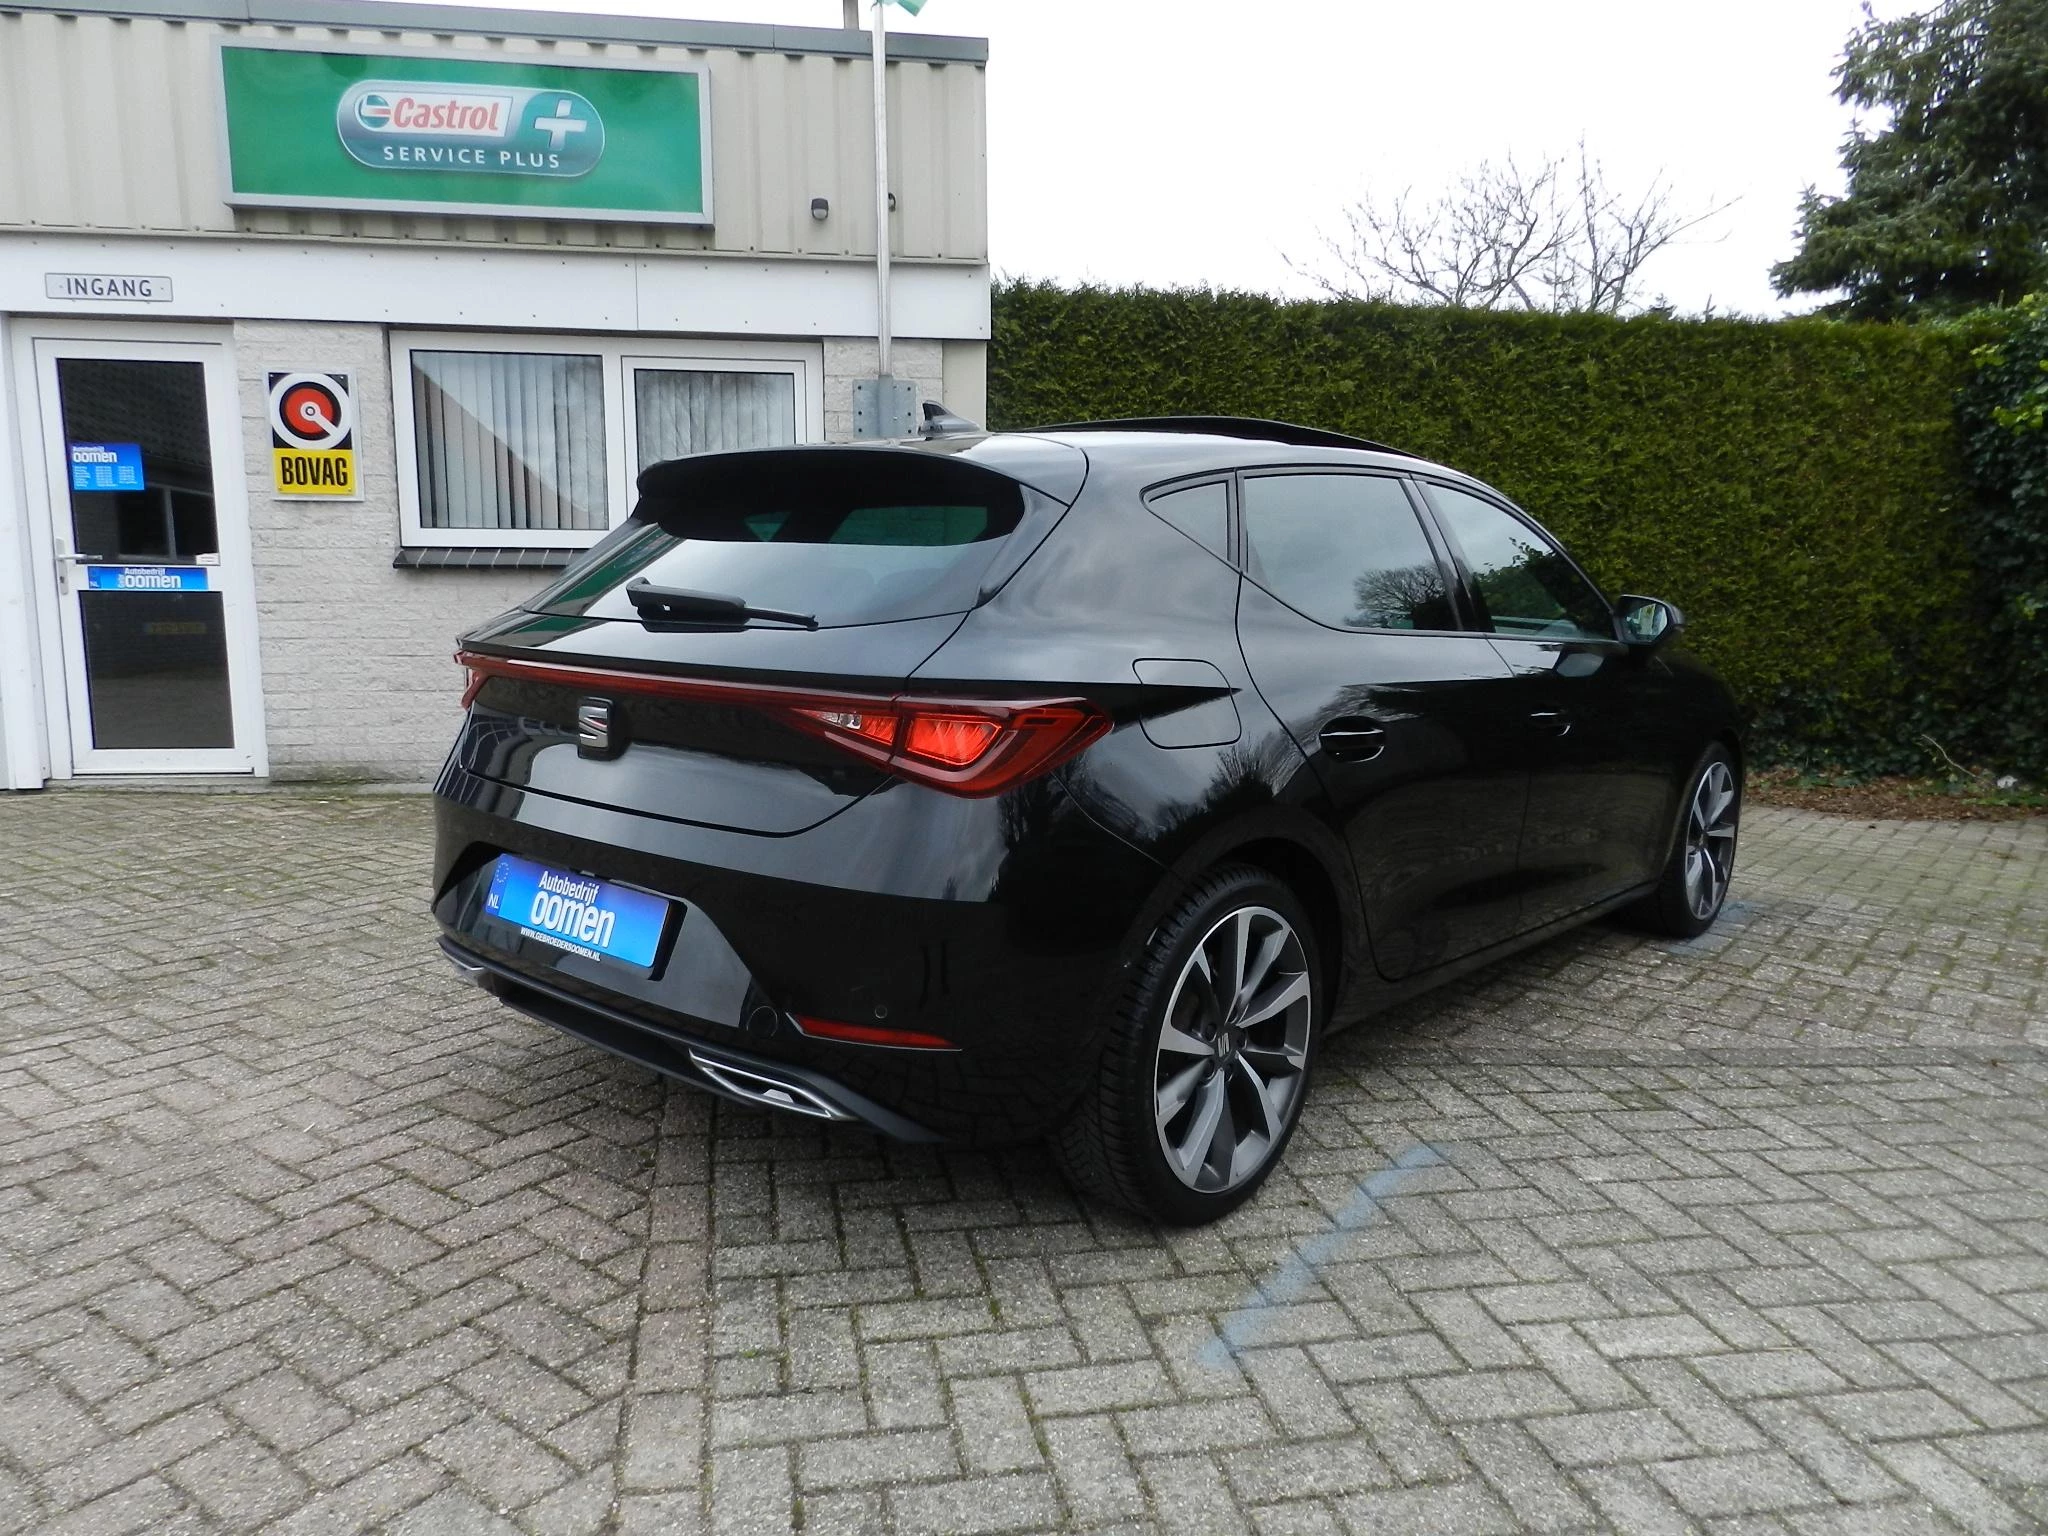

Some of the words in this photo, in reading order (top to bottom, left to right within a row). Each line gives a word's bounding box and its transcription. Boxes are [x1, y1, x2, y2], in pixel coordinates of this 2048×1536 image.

[393, 97, 499, 131] Castrol
[383, 146, 486, 165] SERVICE
[500, 151, 560, 169] PLUS
[66, 277, 152, 297] INGANG
[73, 451, 118, 463] oomen
[281, 456, 348, 487] BOVAG
[125, 575, 182, 589] oomen
[538, 870, 600, 907] Autobedrijf
[487, 892, 501, 910] NL
[530, 891, 616, 948] oomen
